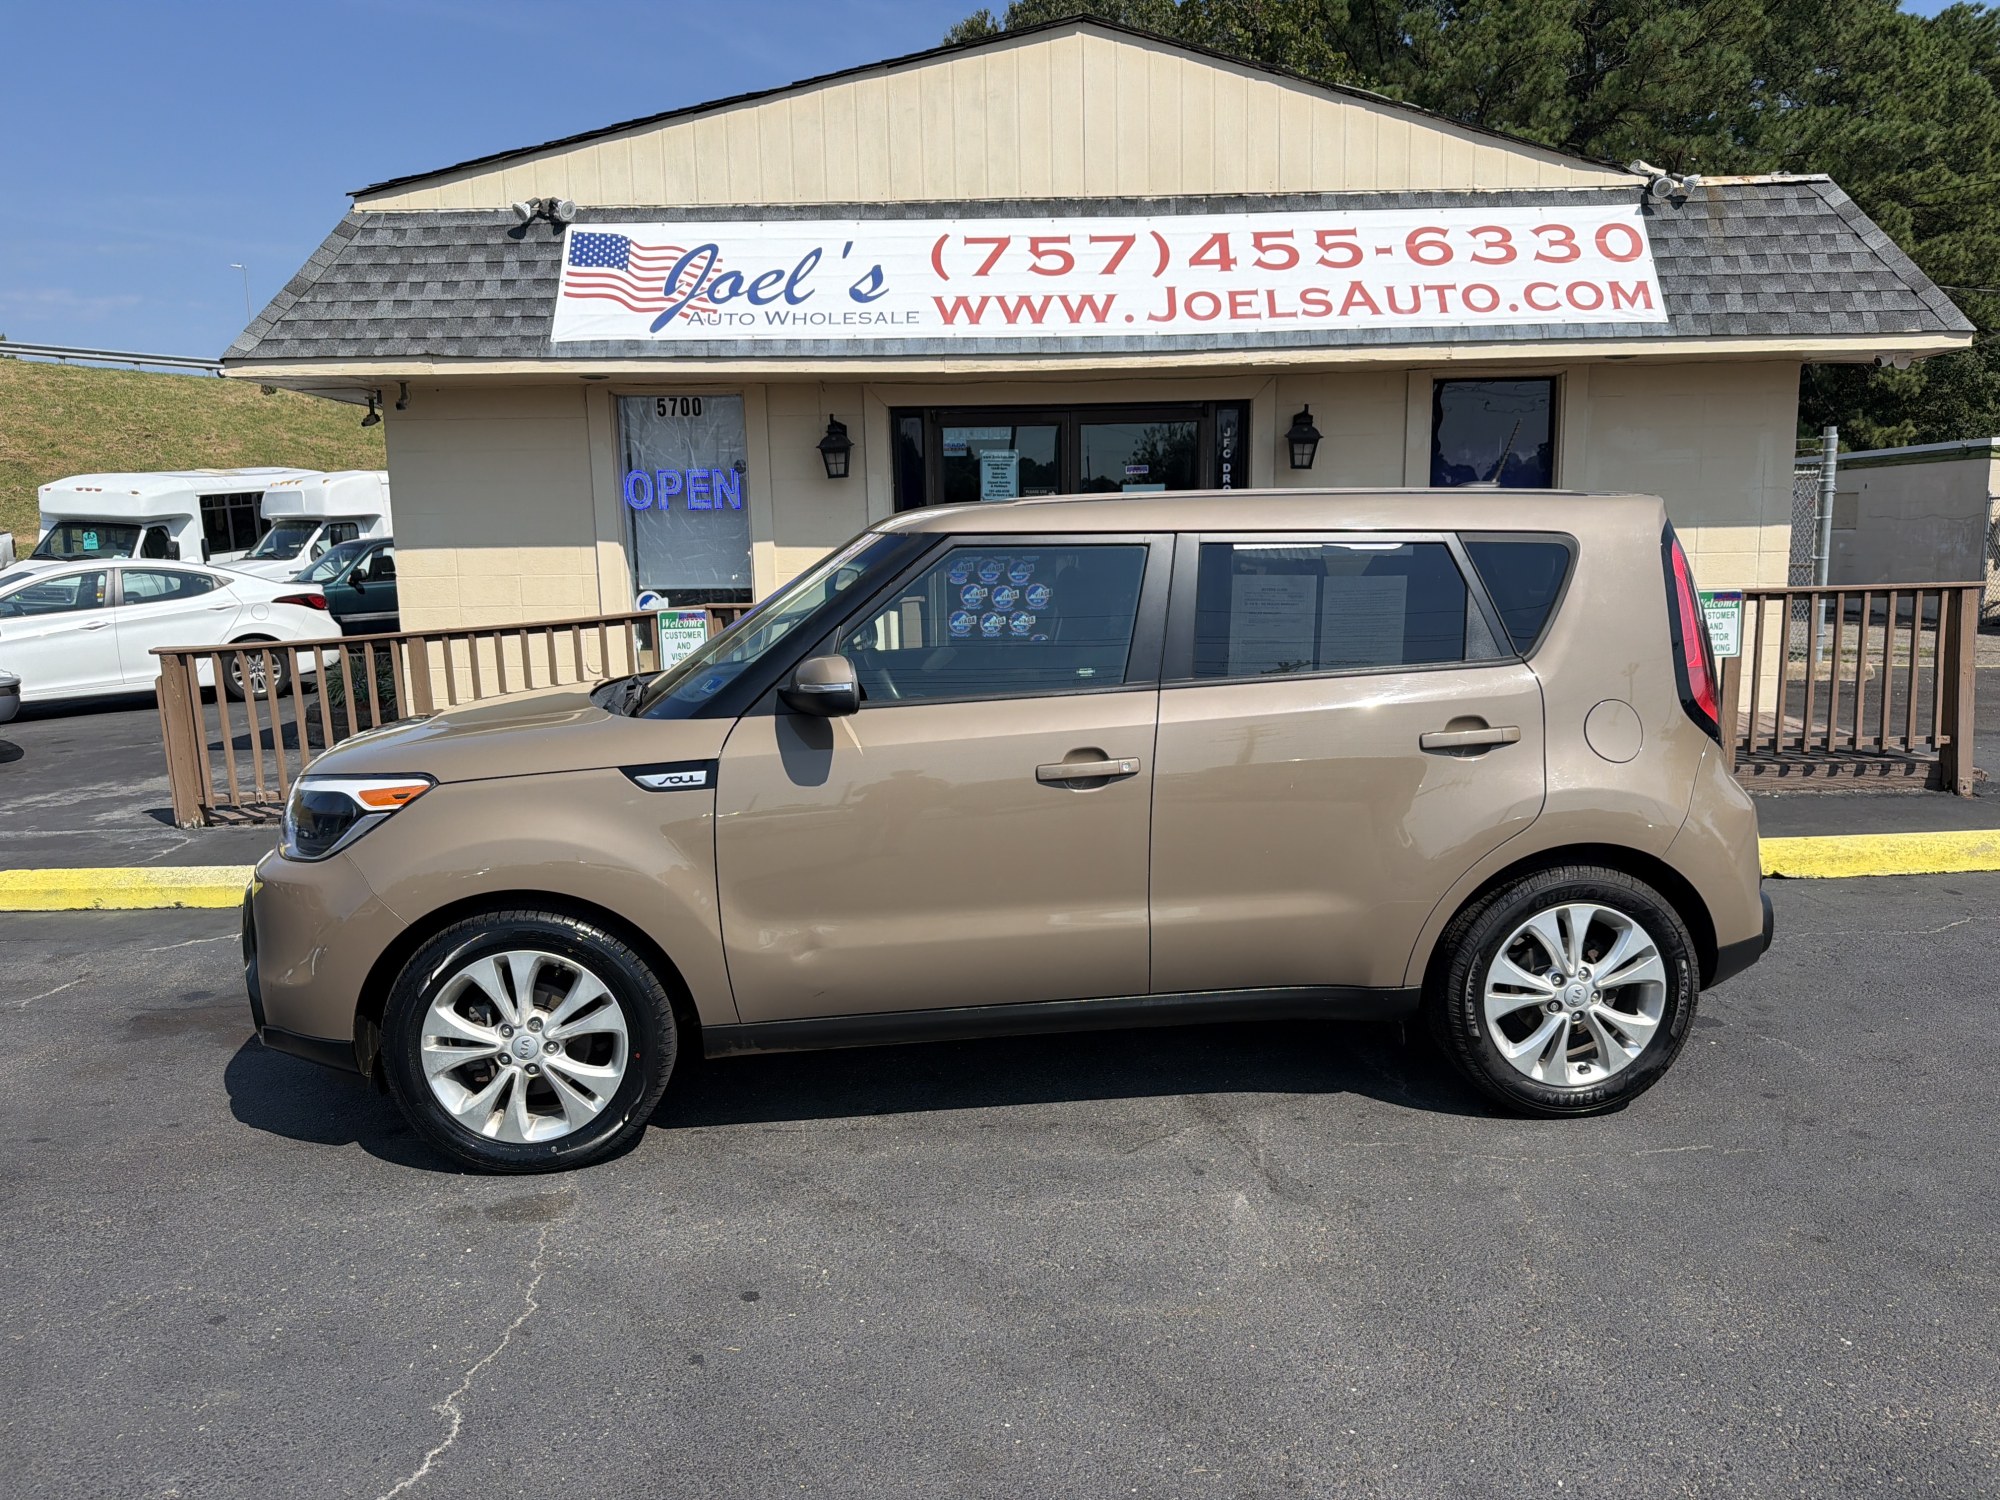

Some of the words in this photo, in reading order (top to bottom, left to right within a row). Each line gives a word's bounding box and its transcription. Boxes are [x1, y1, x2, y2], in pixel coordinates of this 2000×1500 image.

[931, 222, 1645, 281] (757)455-6330
[649, 240, 890, 334] Joel's
[687, 310, 756, 326] AUTO
[764, 309, 920, 325] WHOLESALE
[657, 397, 702, 417] 5700
[624, 468, 742, 511] OPEN
[662, 619, 702, 628] Welcome
[1704, 611, 1735, 619] STOMER
[665, 631, 702, 639] CUSTOMER
[1709, 632, 1729, 641] SITOR
[677, 642, 691, 650] AND
[1713, 643, 1731, 652] KING
[672, 653, 692, 661] VISIT
[1467, 961, 1483, 1030] ALL-SEASON
[1569, 988, 1583, 1006] KIA
[519, 1039, 530, 1058] KIA
